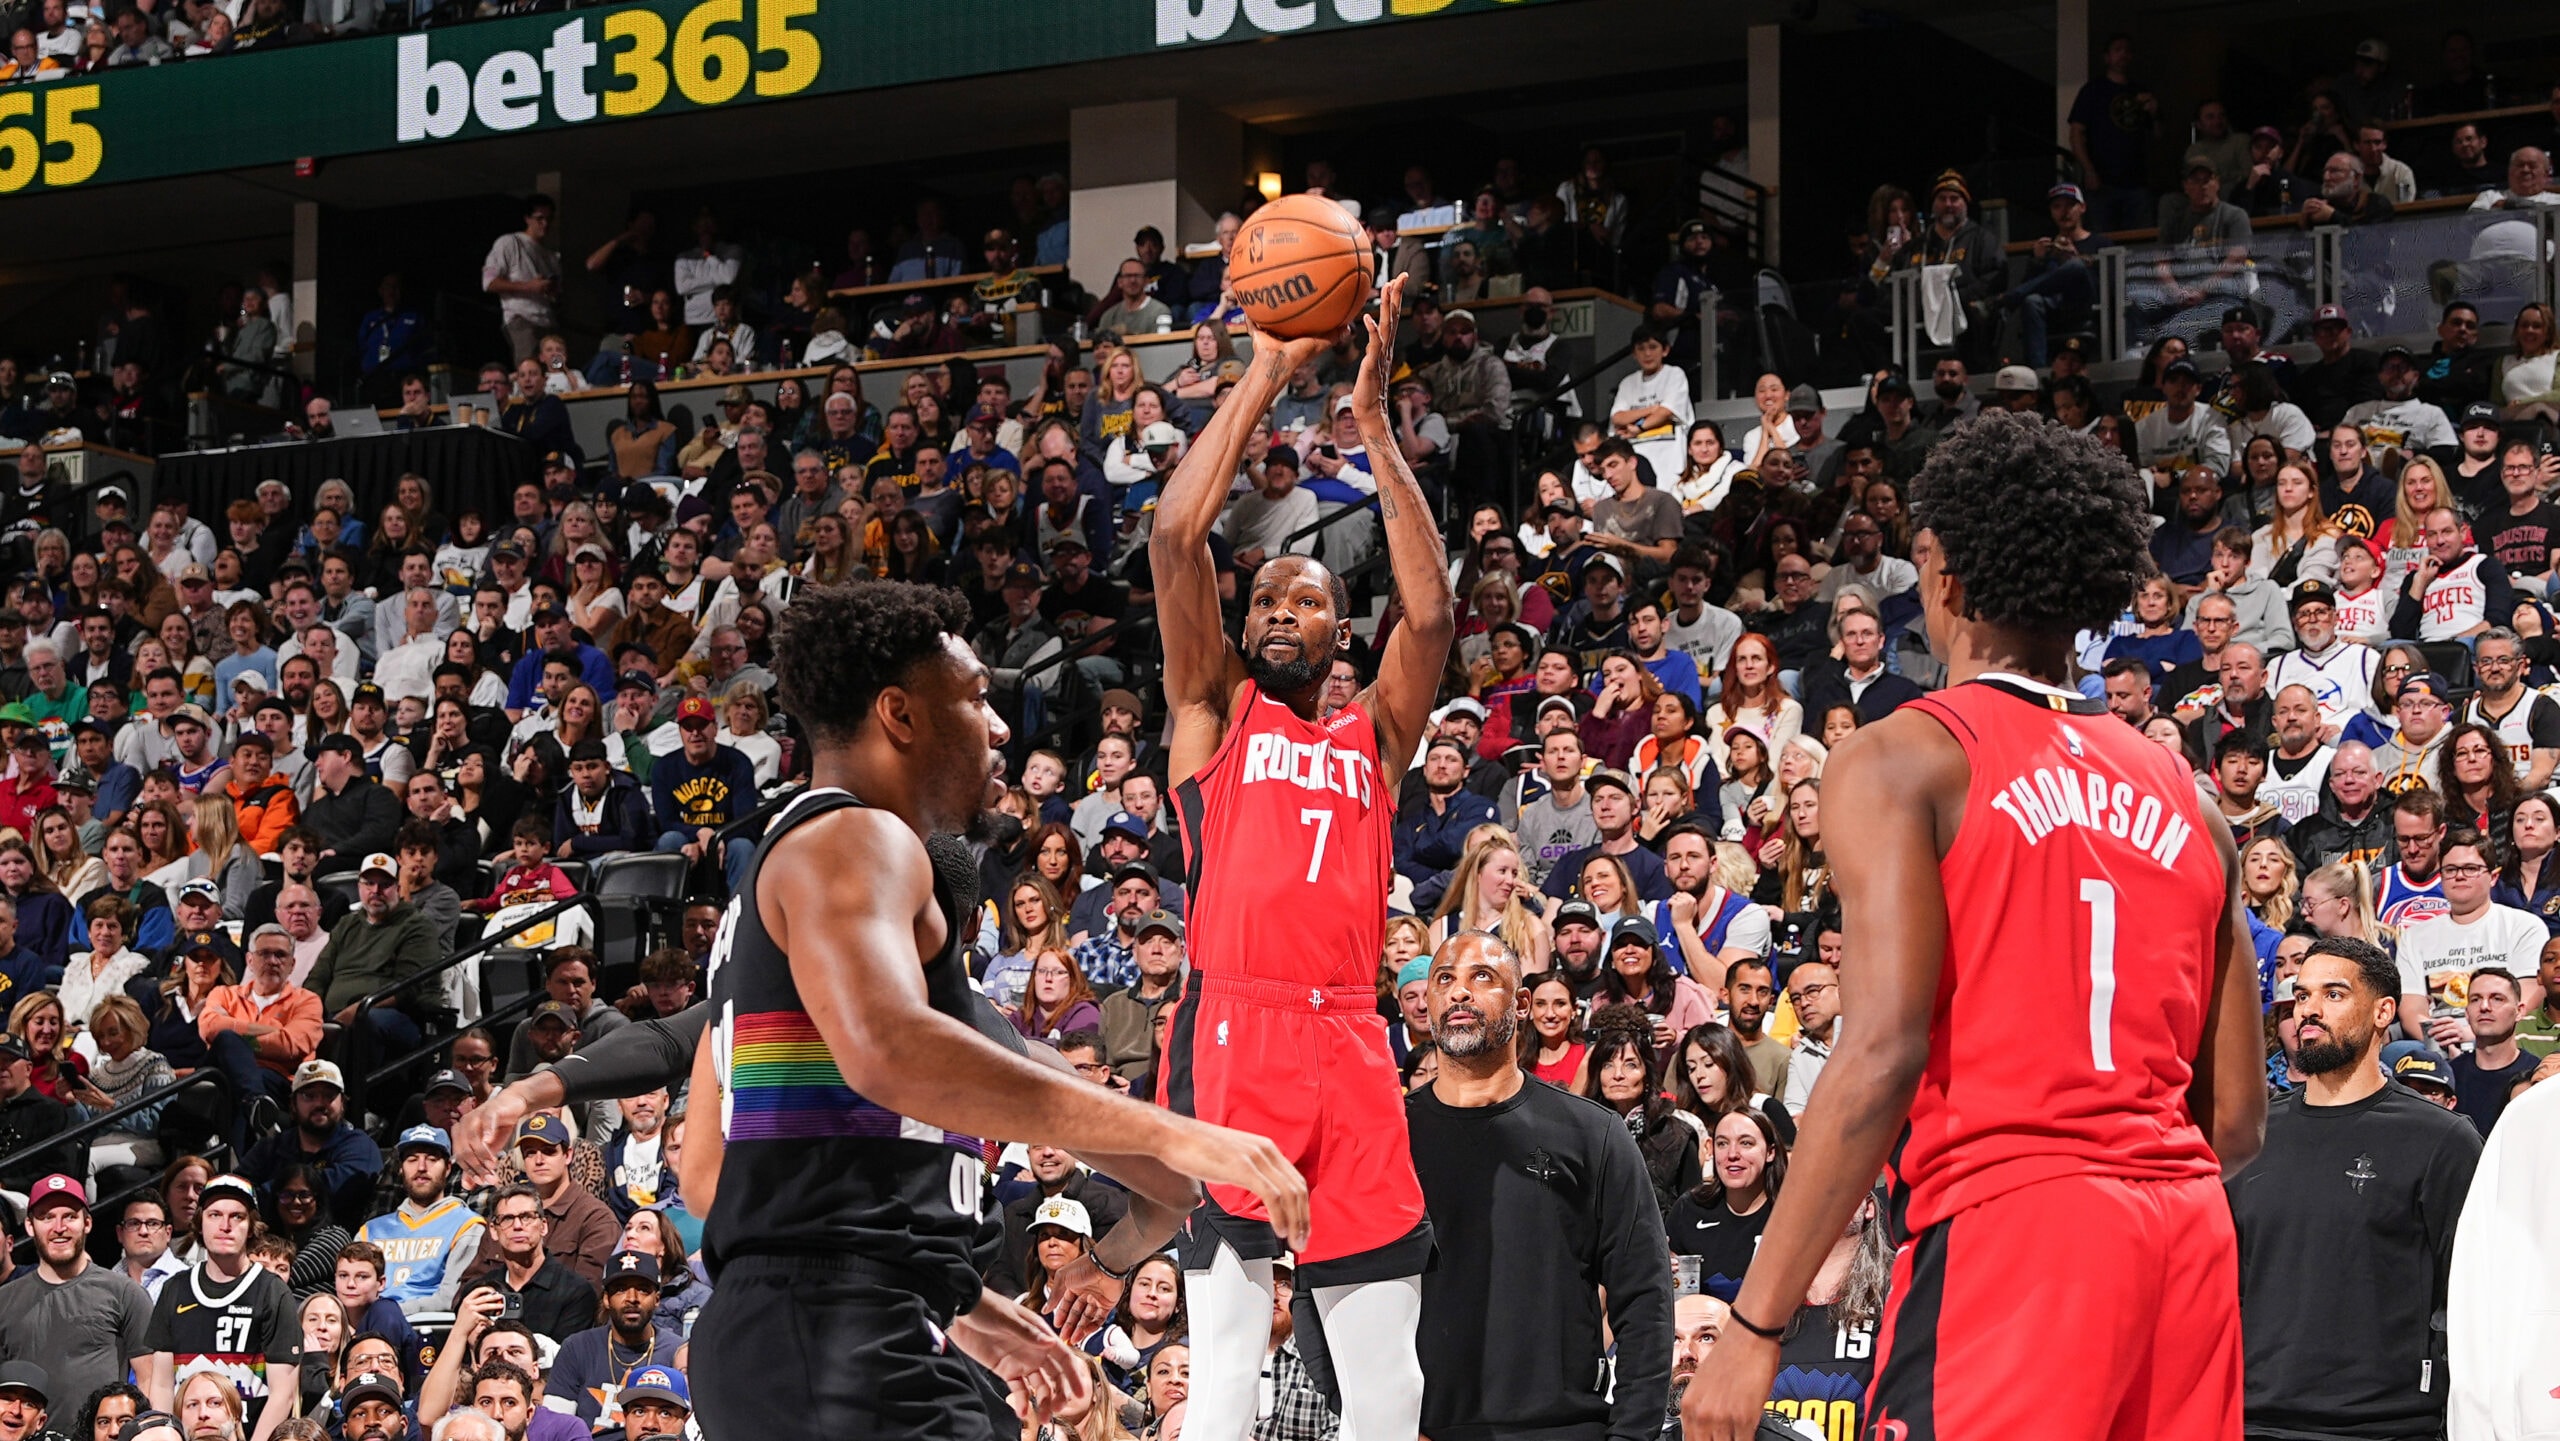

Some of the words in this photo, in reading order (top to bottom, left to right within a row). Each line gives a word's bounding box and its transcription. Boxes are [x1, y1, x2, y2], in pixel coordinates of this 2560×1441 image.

[398, 0, 822, 142] bet365
[1235, 273, 1318, 310] Wilson
[1551, 304, 1591, 335] EXIT
[2492, 525, 2549, 551] HOUSTON
[2337, 607, 2375, 625] CKETS
[2423, 586, 2473, 613] OCKETS
[1242, 732, 1372, 810] ROCKETS
[672, 776, 729, 805] NUGGETS
[1991, 766, 2192, 870] THOMPSON
[1301, 808, 1333, 883] 7
[2449, 948, 2465, 957] GIVE
[2470, 946, 2484, 955] THE
[2468, 956, 2474, 965] A
[2476, 953, 2508, 964] CHANCE
[2080, 878, 2116, 1072] 1
[228, 1305, 253, 1315] ibotta
[216, 1315, 252, 1353] 27
[1835, 1319, 1874, 1359] 15
